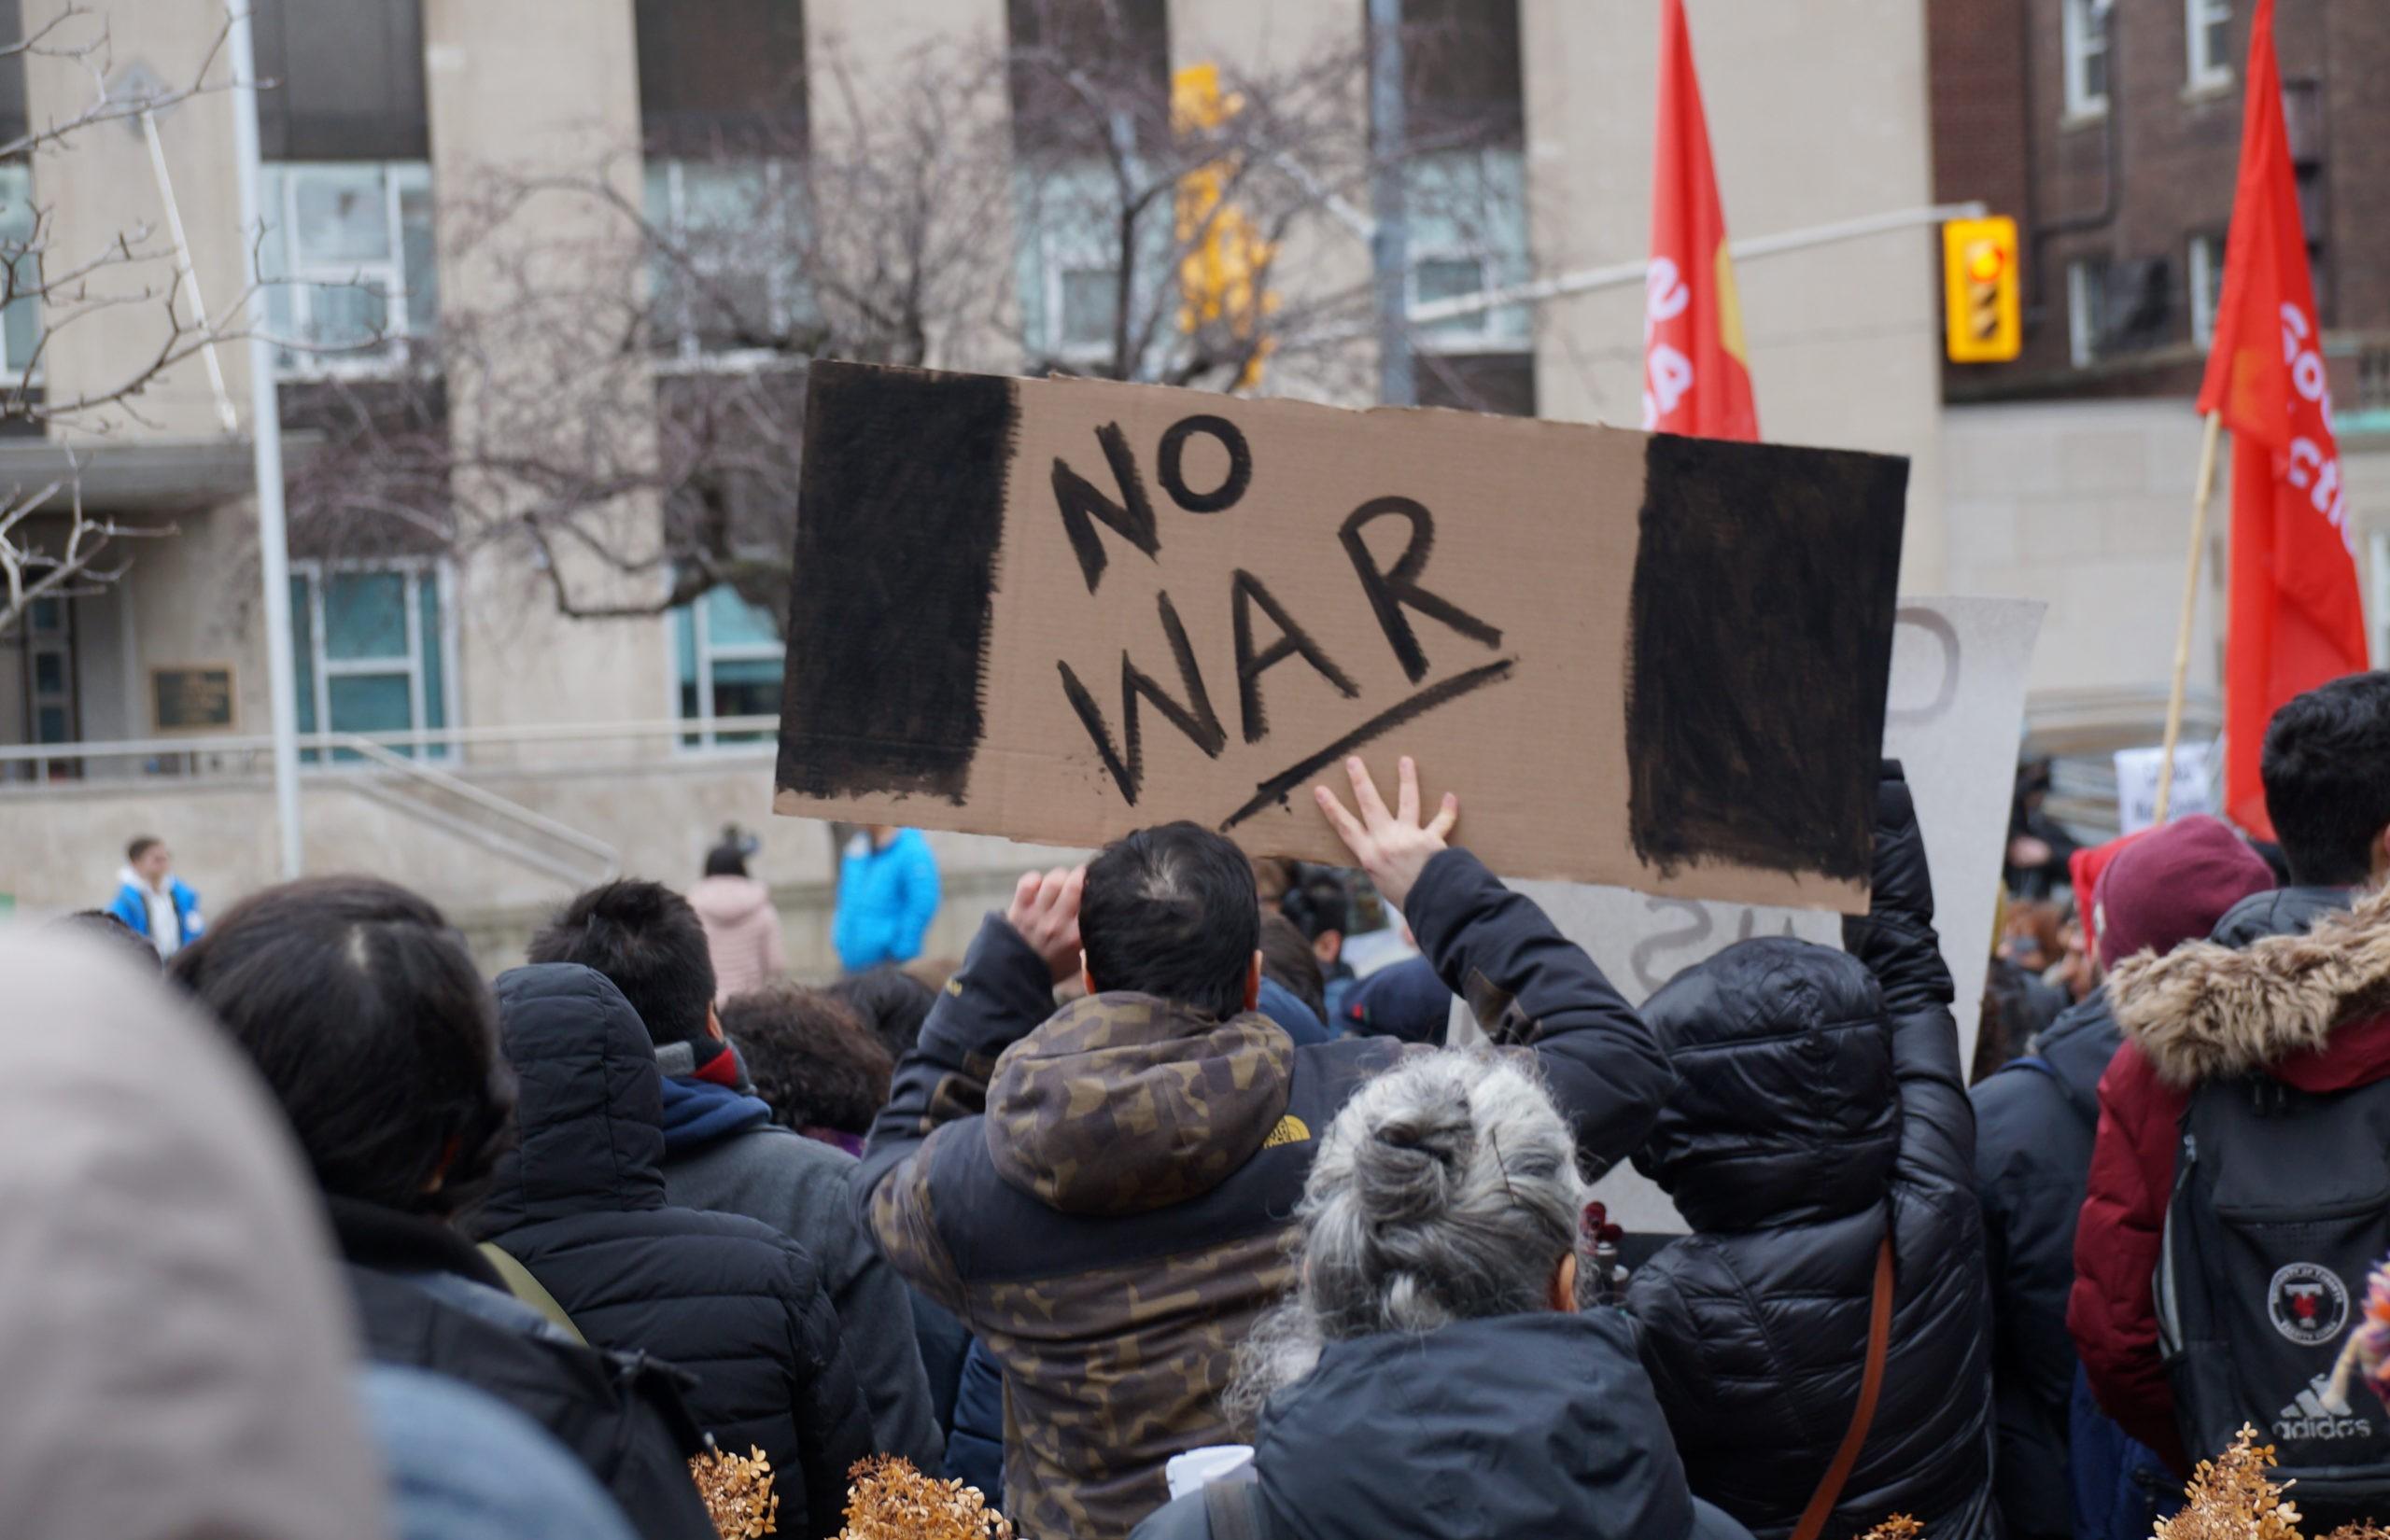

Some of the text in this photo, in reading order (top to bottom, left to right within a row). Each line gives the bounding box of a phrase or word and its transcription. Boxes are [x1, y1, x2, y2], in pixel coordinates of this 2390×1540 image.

[1052, 413, 1252, 595] NO
[1058, 496, 1503, 806] WAR
[2271, 1415, 2371, 1440] adidas
